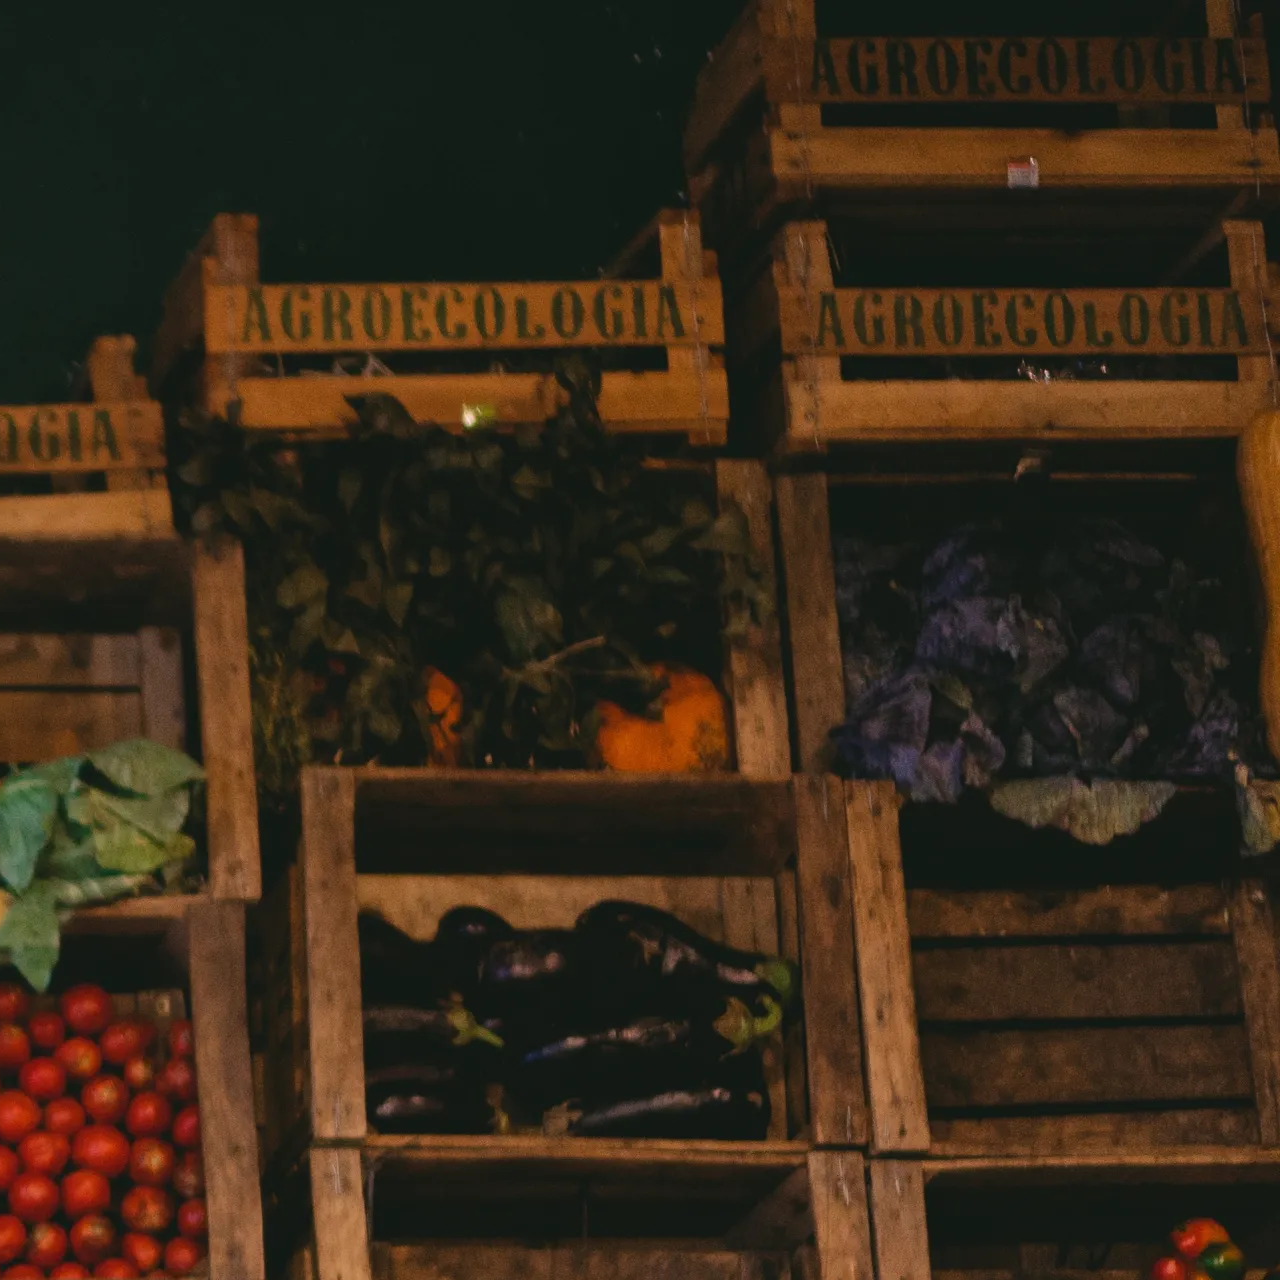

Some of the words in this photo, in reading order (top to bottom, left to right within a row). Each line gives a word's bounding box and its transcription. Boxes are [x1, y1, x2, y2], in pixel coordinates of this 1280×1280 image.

[811, 37, 1248, 96] AGROECOLOGIA
[243, 285, 687, 342] AGROECOLOGIA
[817, 290, 1251, 348] AGROECOLOGIA
